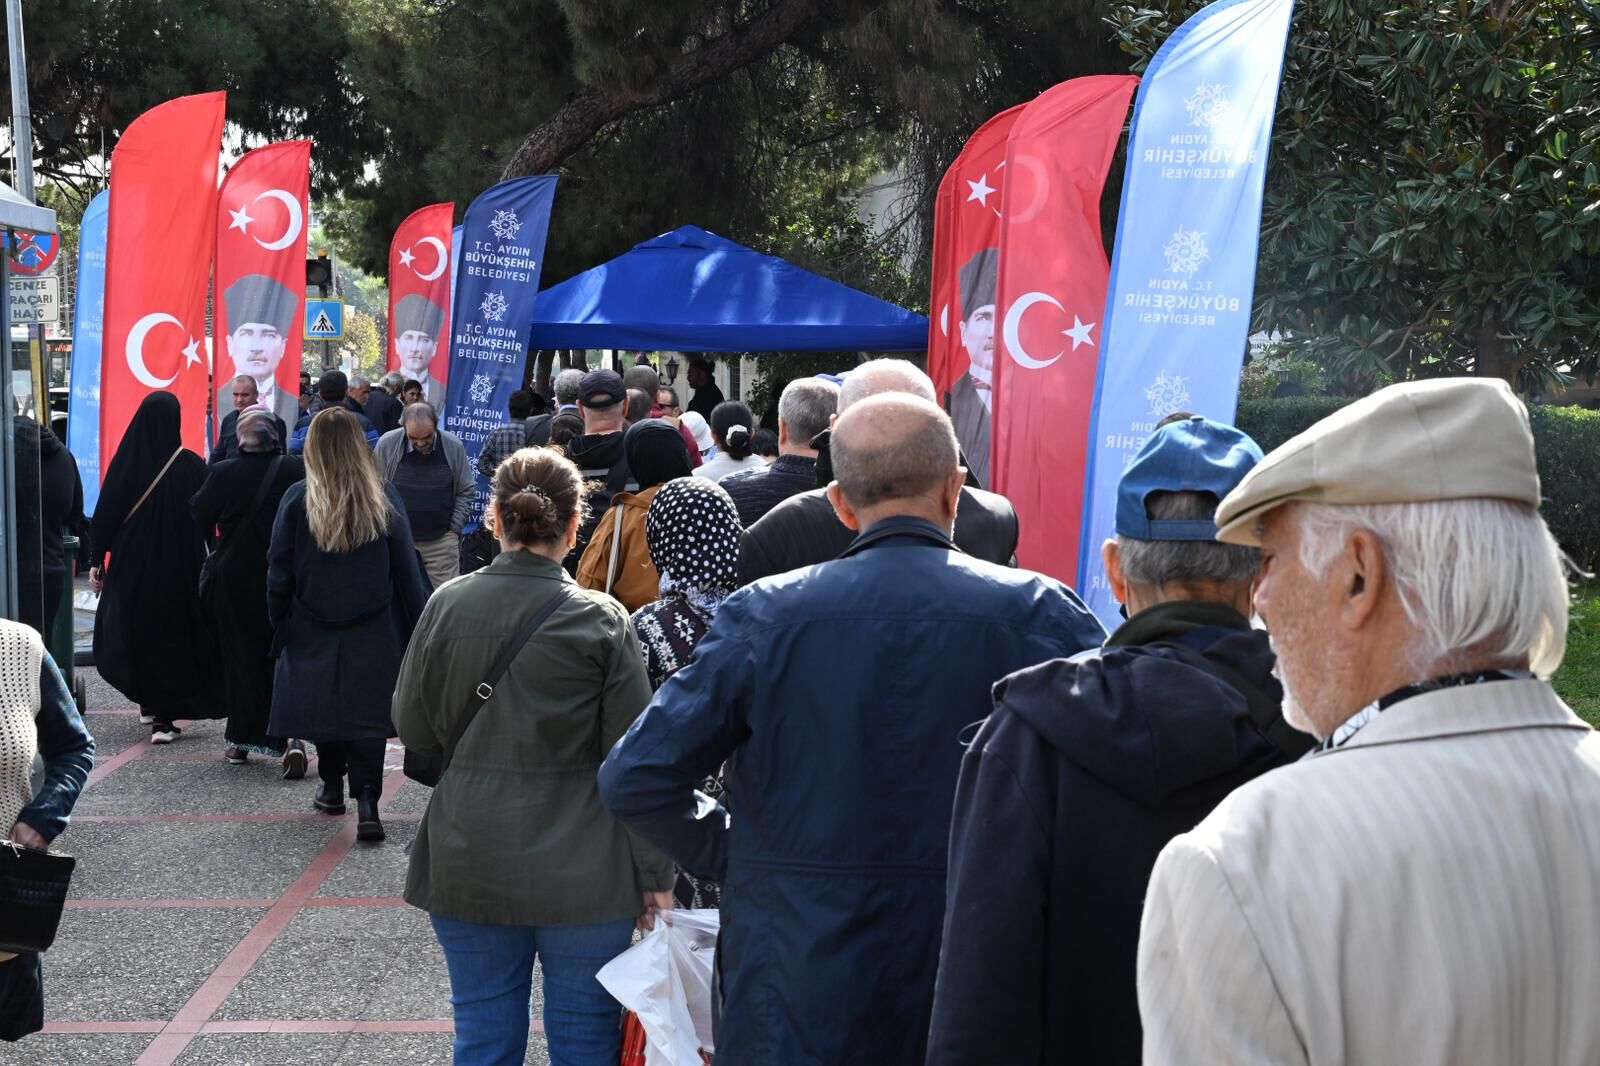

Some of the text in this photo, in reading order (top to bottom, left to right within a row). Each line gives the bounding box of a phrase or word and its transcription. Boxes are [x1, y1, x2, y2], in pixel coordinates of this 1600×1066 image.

[475, 241, 530, 257] T.C. AYDIN
[465, 251, 536, 270] BÜYÜKŞEHİR
[468, 265, 530, 282] BELEDİYESİ
[466, 323, 517, 338] T.C. AYDIN
[456, 333, 522, 352] BÜYÜKŞEHİR
[458, 348, 517, 364] BELEDİYESİ
[456, 405, 503, 420] T.C. AYDIN
[447, 416, 503, 431] BÜYÜKŞEHİ
